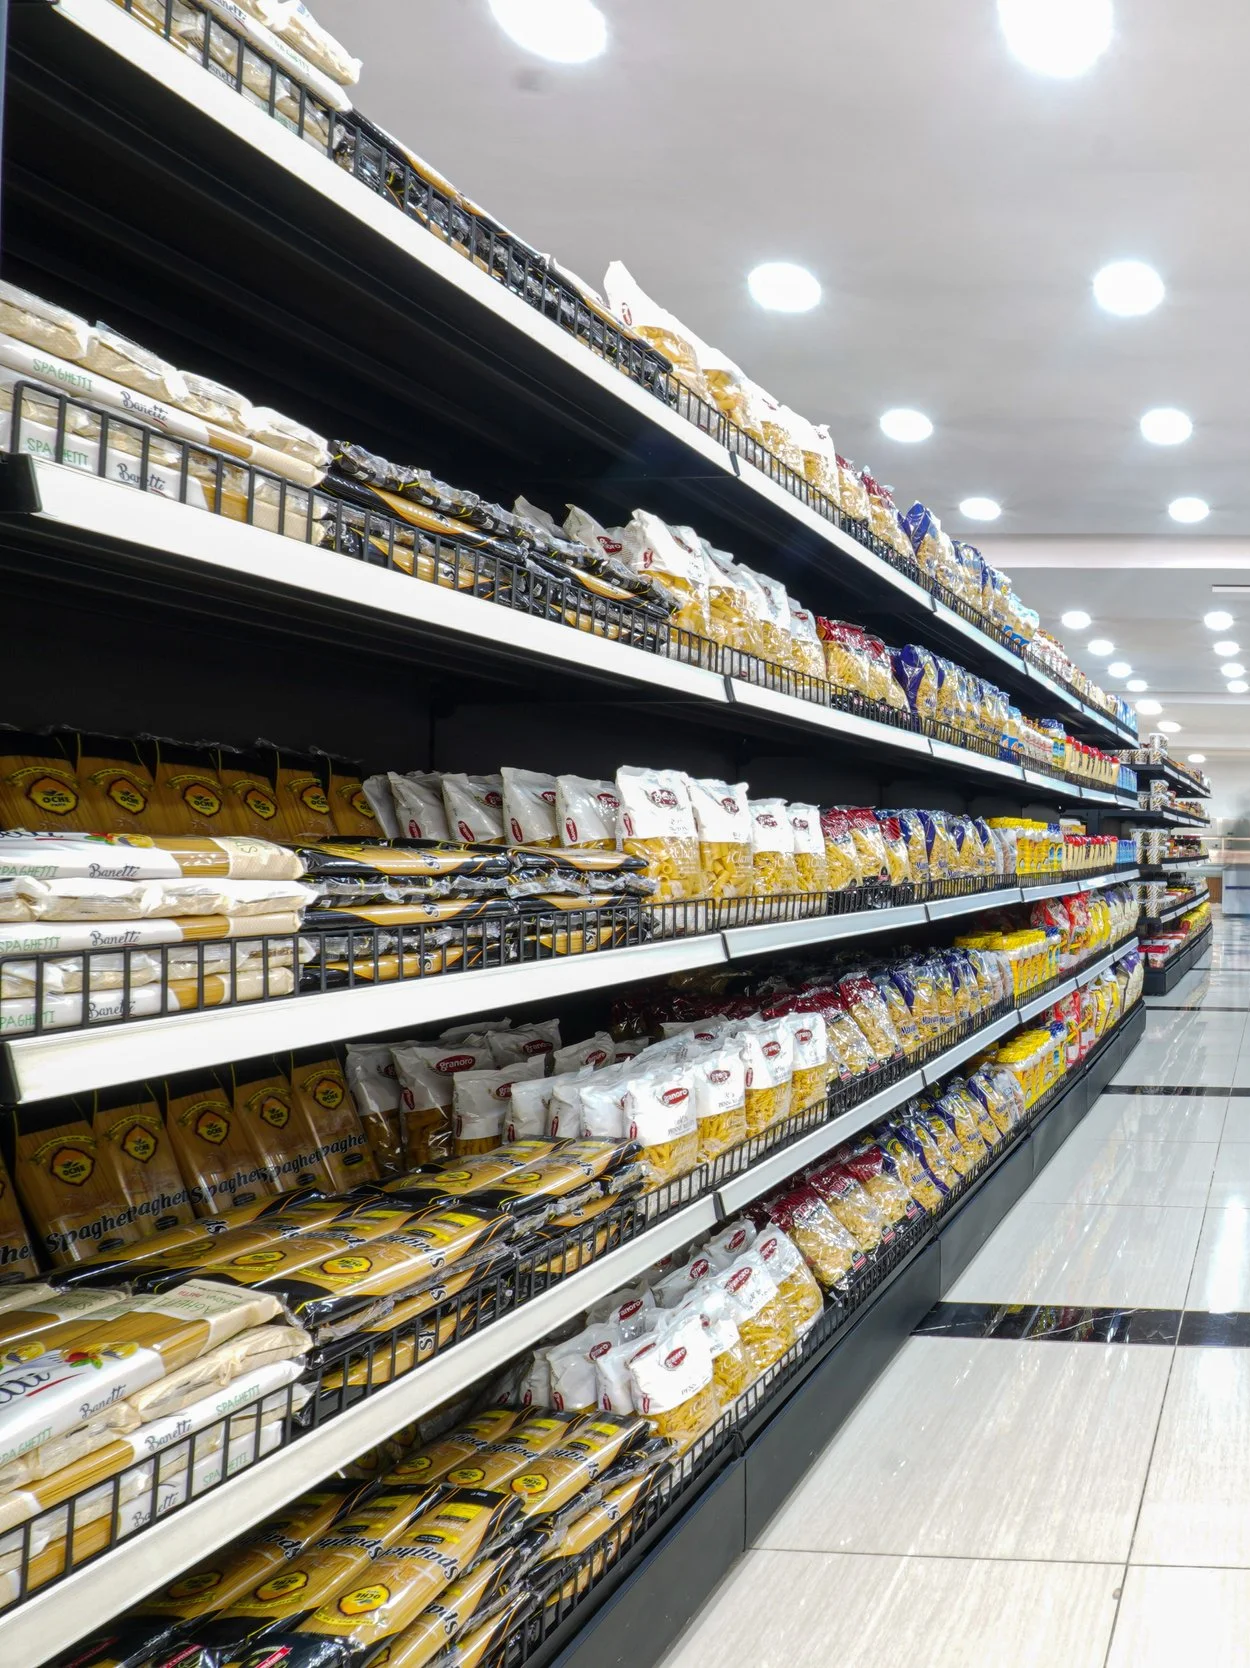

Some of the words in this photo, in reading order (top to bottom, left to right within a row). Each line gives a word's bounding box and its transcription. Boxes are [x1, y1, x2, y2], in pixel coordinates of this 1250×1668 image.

[33, 358, 93, 392] SPAGHETTI
[119, 390, 169, 422] Banetti
[27, 437, 90, 467] SPAHETTI
[116, 462, 166, 492] Baetti
[88, 863, 140, 880] Banetti
[90, 929, 141, 947] Banetti
[439, 1055, 474, 1072] granoro
[79, 1383, 126, 1419] Banetti
[215, 1384, 261, 1415] SPAGHETTI
[144, 1418, 192, 1451] Banetti
[202, 1451, 249, 1488] SPAHETTI
[132, 1492, 179, 1528] Baetti
